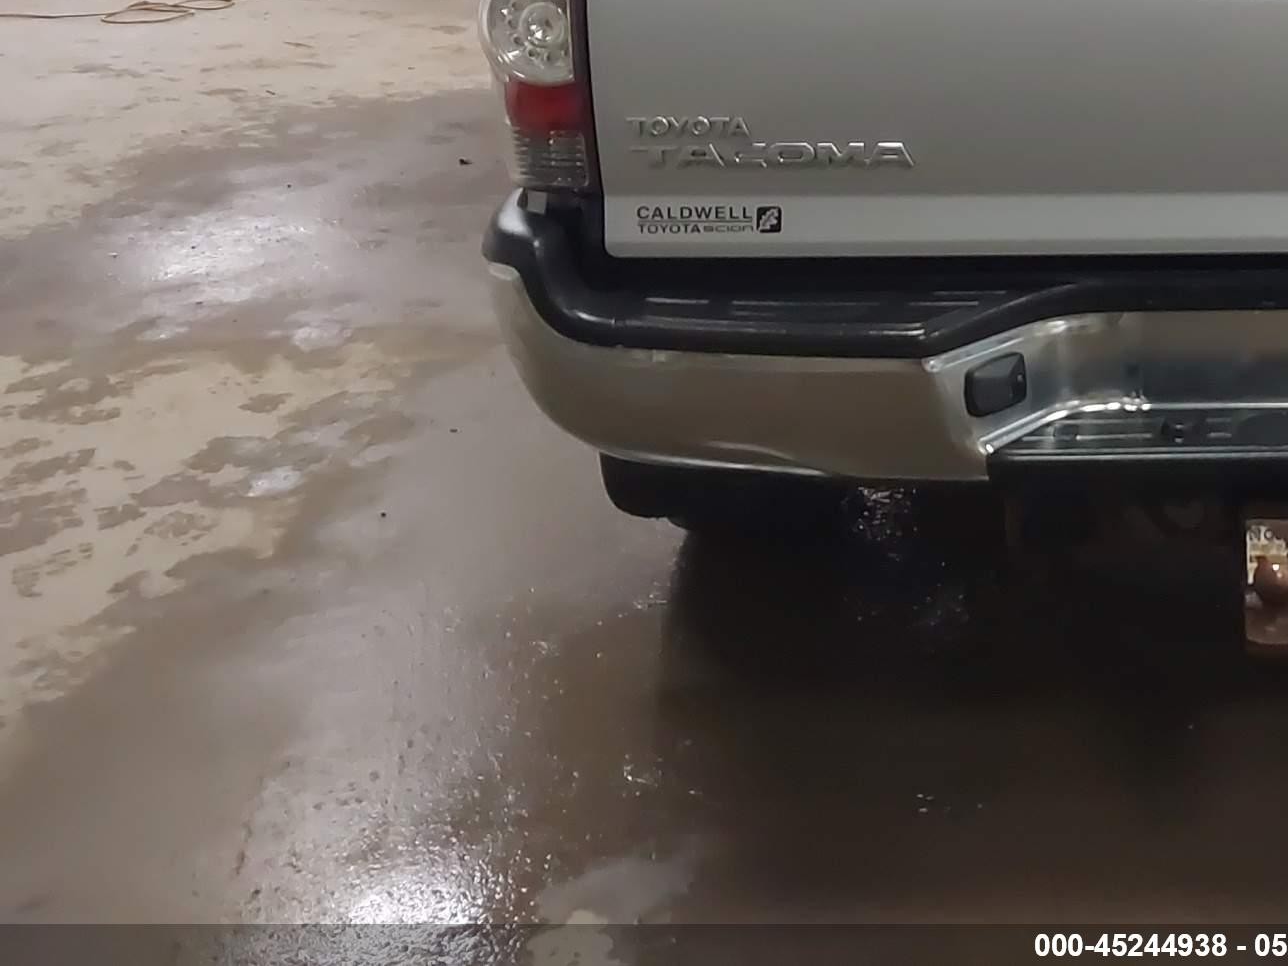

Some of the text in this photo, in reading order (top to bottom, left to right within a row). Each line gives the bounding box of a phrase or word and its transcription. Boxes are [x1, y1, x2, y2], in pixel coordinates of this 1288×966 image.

[626, 116, 750, 136] TOYOTA
[629, 142, 914, 168] TACOMA
[637, 206, 753, 220] CALDWELL
[638, 223, 700, 234] TOYOTA
